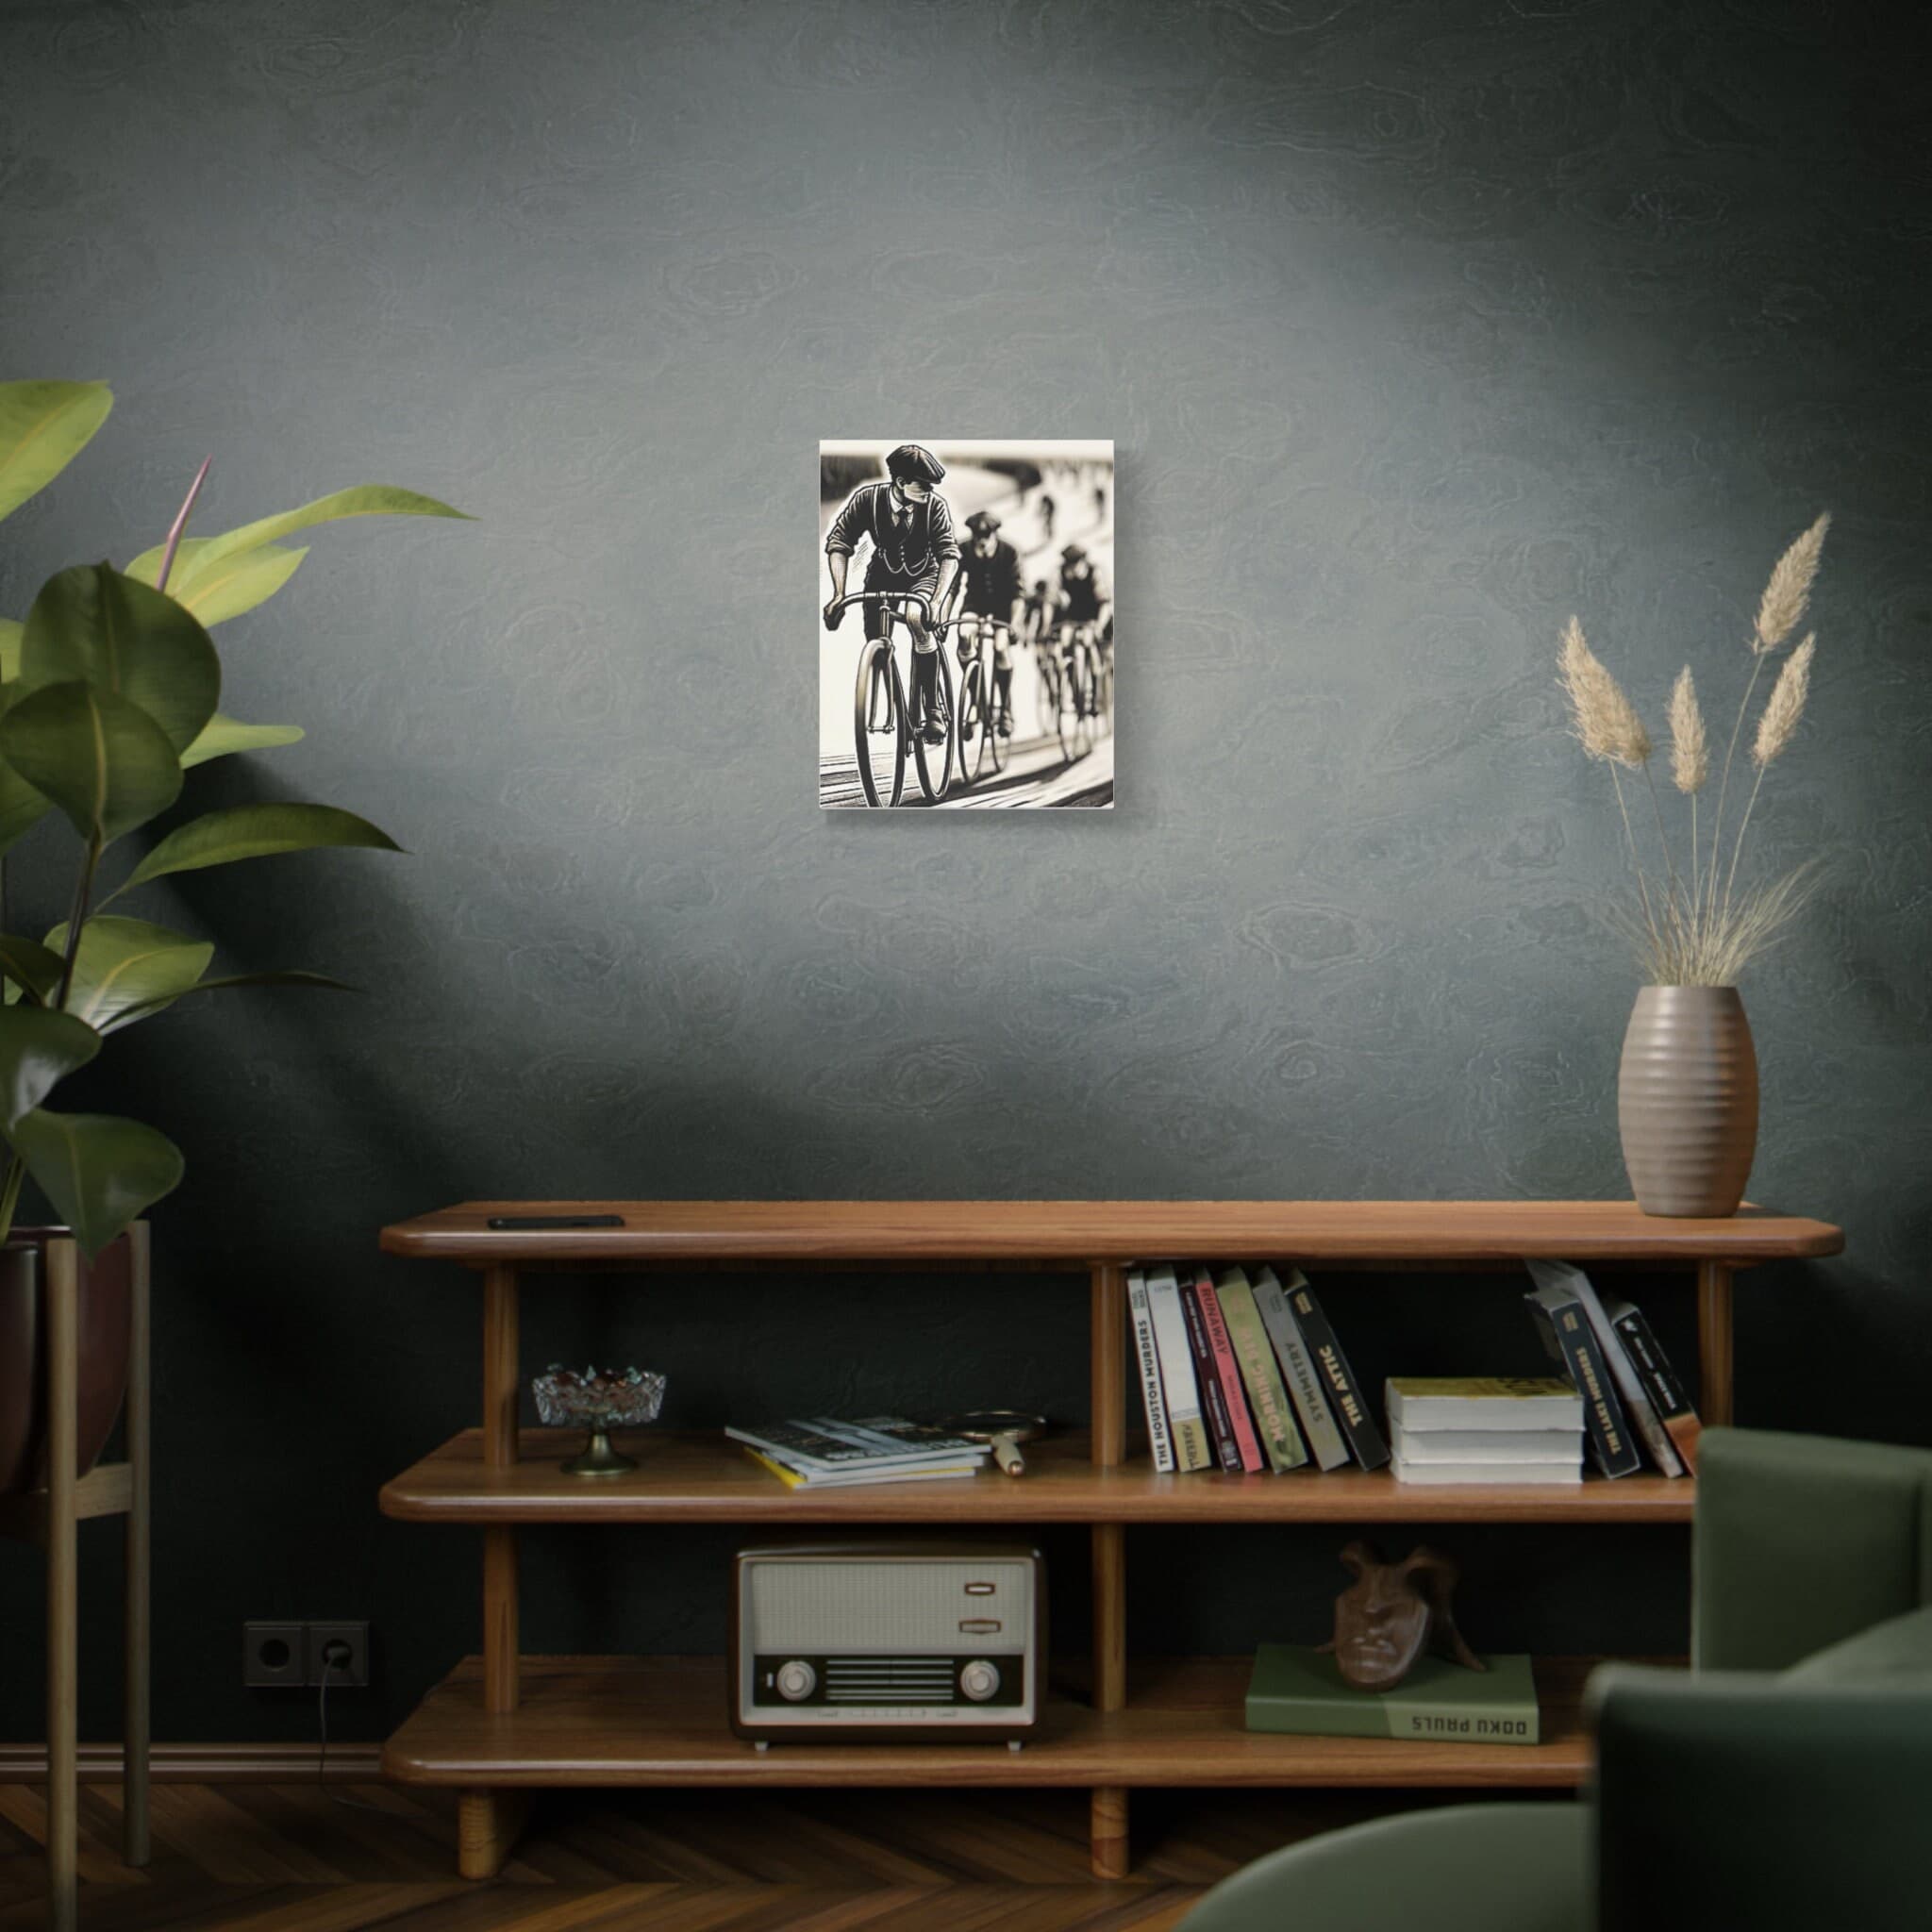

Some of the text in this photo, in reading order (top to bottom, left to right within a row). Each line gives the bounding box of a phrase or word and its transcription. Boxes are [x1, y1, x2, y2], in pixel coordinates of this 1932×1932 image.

[1138, 1320, 1155, 1377] MURDERS
[1201, 1288, 1229, 1354] RUNAWAY
[1286, 1342, 1323, 1423] SYMMETRY
[1319, 1344, 1363, 1427] THE ATTIC
[1576, 1346, 1602, 1400] MURDERS
[1147, 1381, 1163, 1440] HOUSTON
[1253, 1365, 1286, 1442] MORNING
[1158, 1444, 1169, 1466] THE
[1605, 1430, 1622, 1455] THE
[1411, 1715, 1527, 1736] DOKU PAULS
